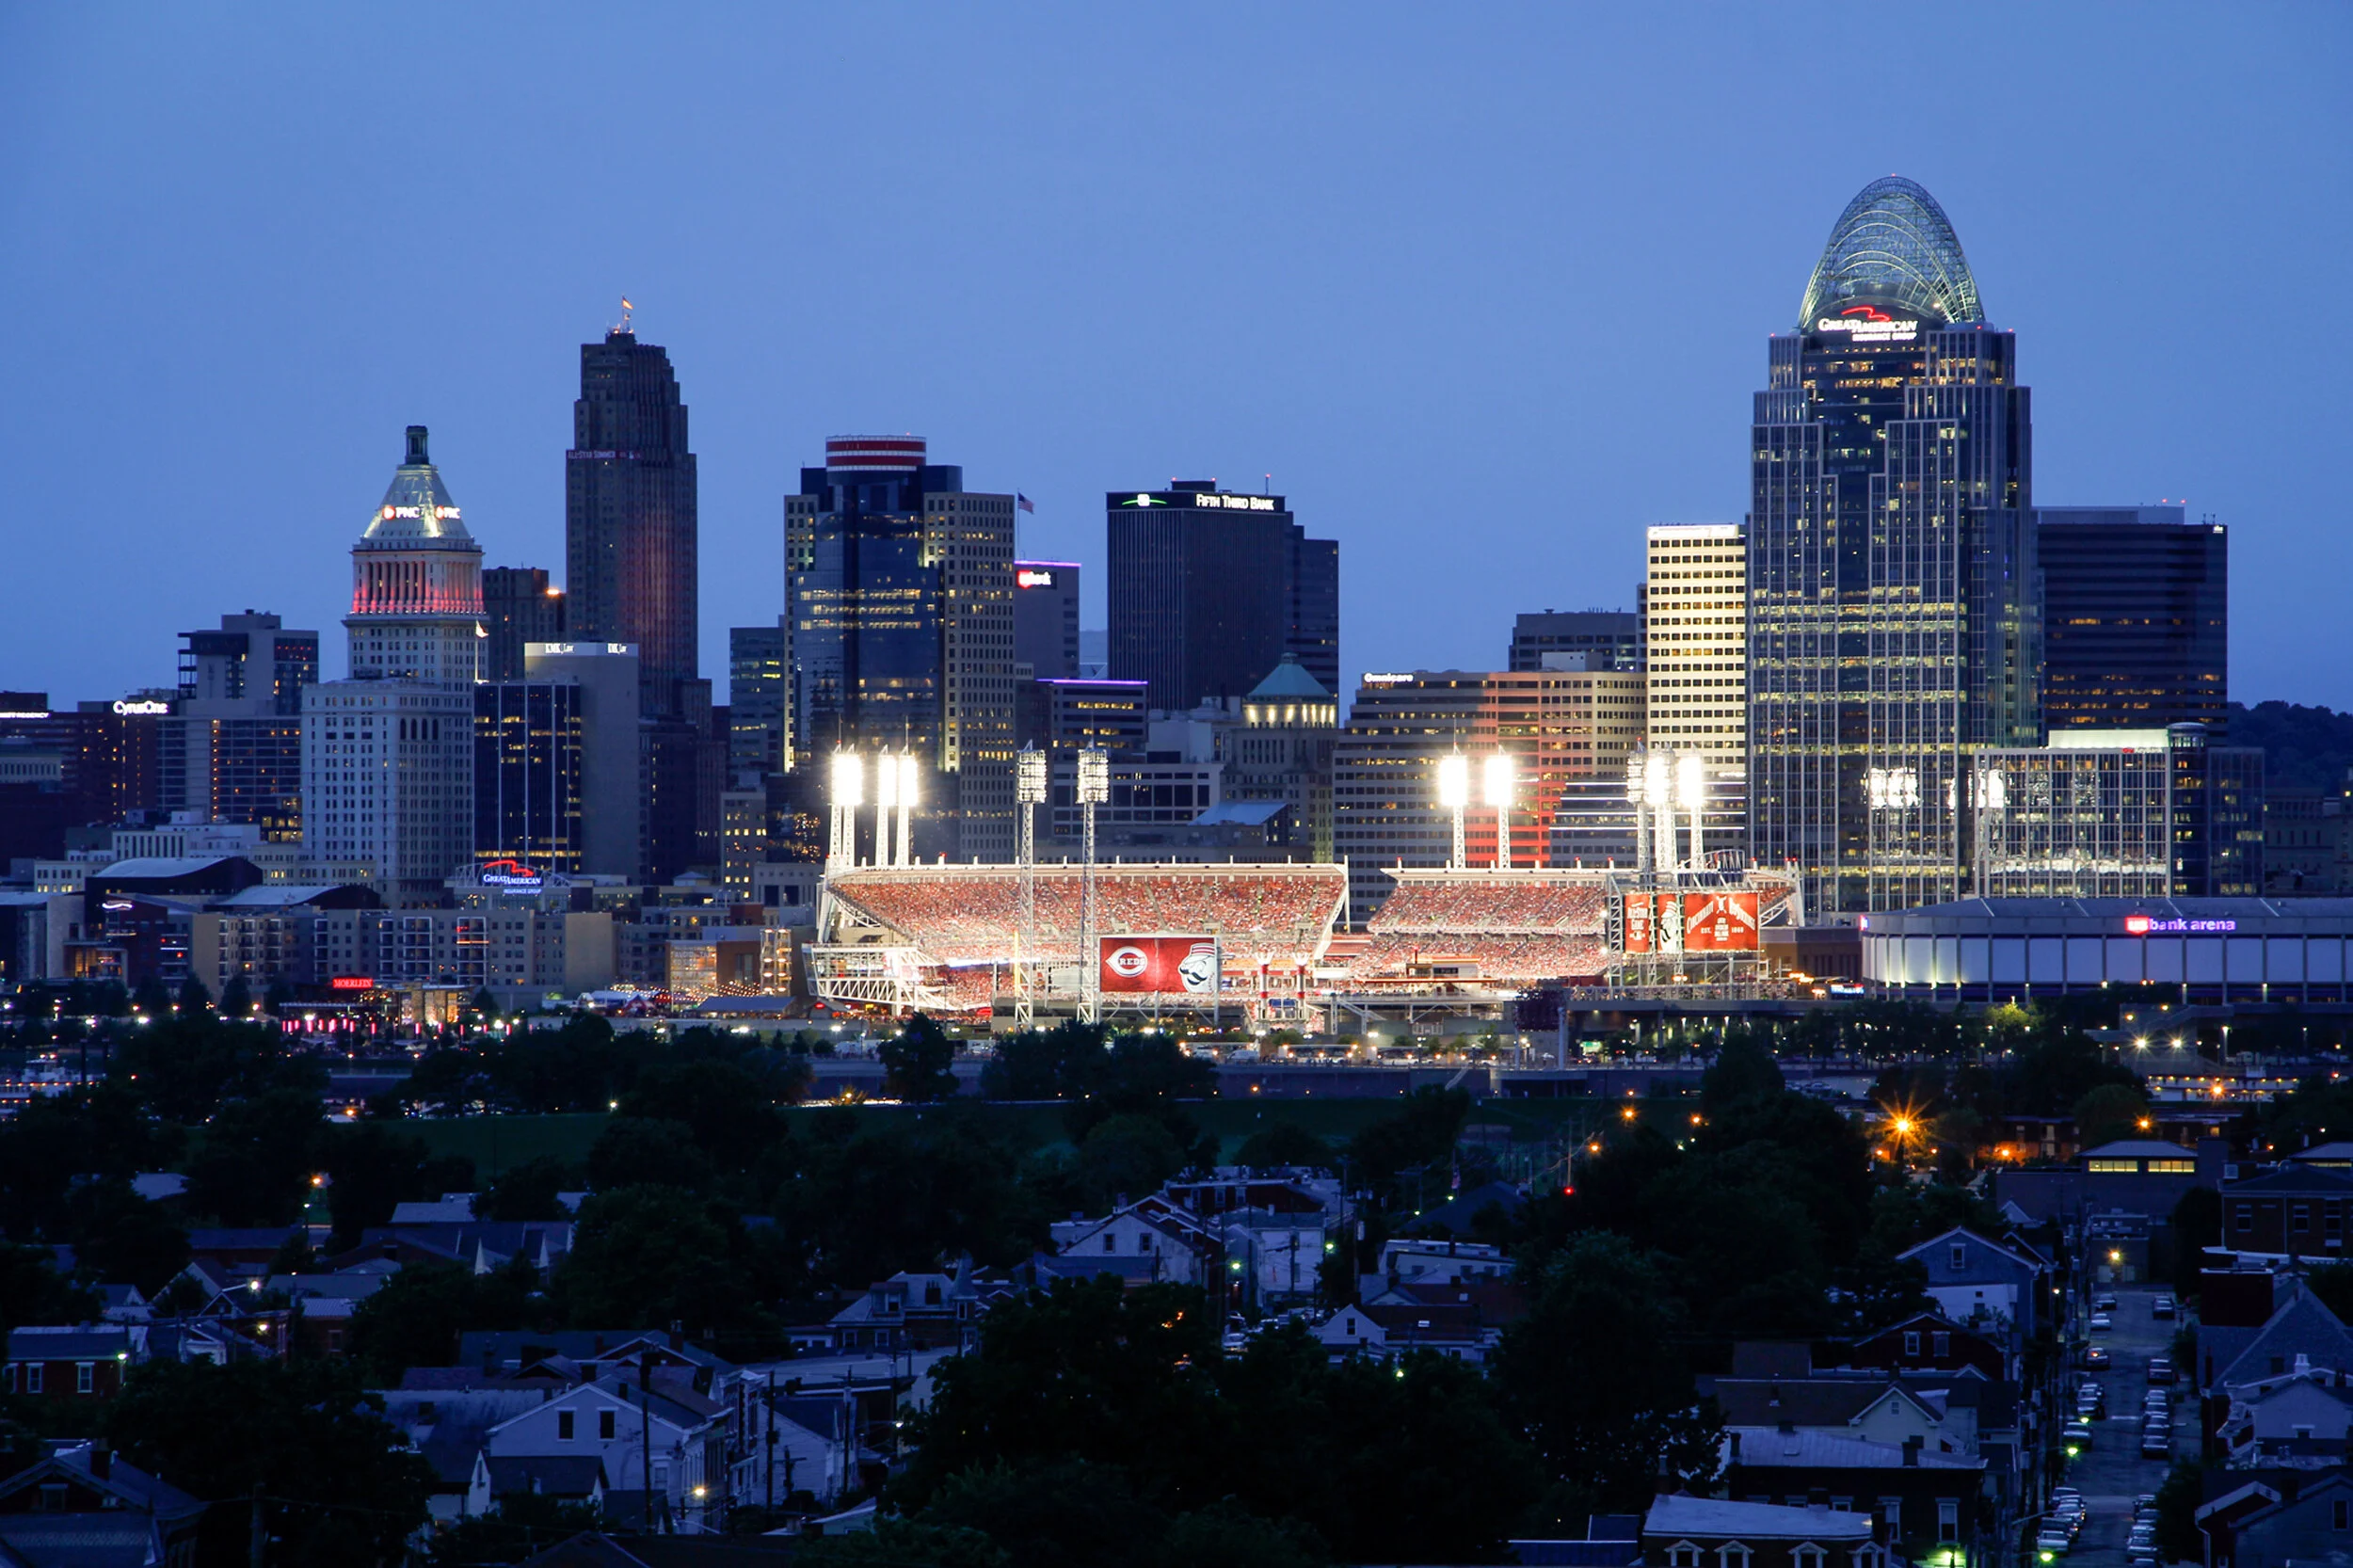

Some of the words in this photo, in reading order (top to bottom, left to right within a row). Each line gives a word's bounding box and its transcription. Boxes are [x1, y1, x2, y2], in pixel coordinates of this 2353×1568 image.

[1852, 319, 1918, 332] AMERICAN
[1195, 494, 1220, 507] FIFTH
[1222, 495, 1249, 509] THIRD
[1250, 497, 1275, 511] BANK
[395, 506, 421, 519] PNC
[113, 700, 169, 715] CyrusOne
[483, 873, 509, 883] GREAT
[504, 875, 542, 885] AMERICAN
[2190, 920, 2236, 931] arena
[1120, 957, 1145, 967] REDS
